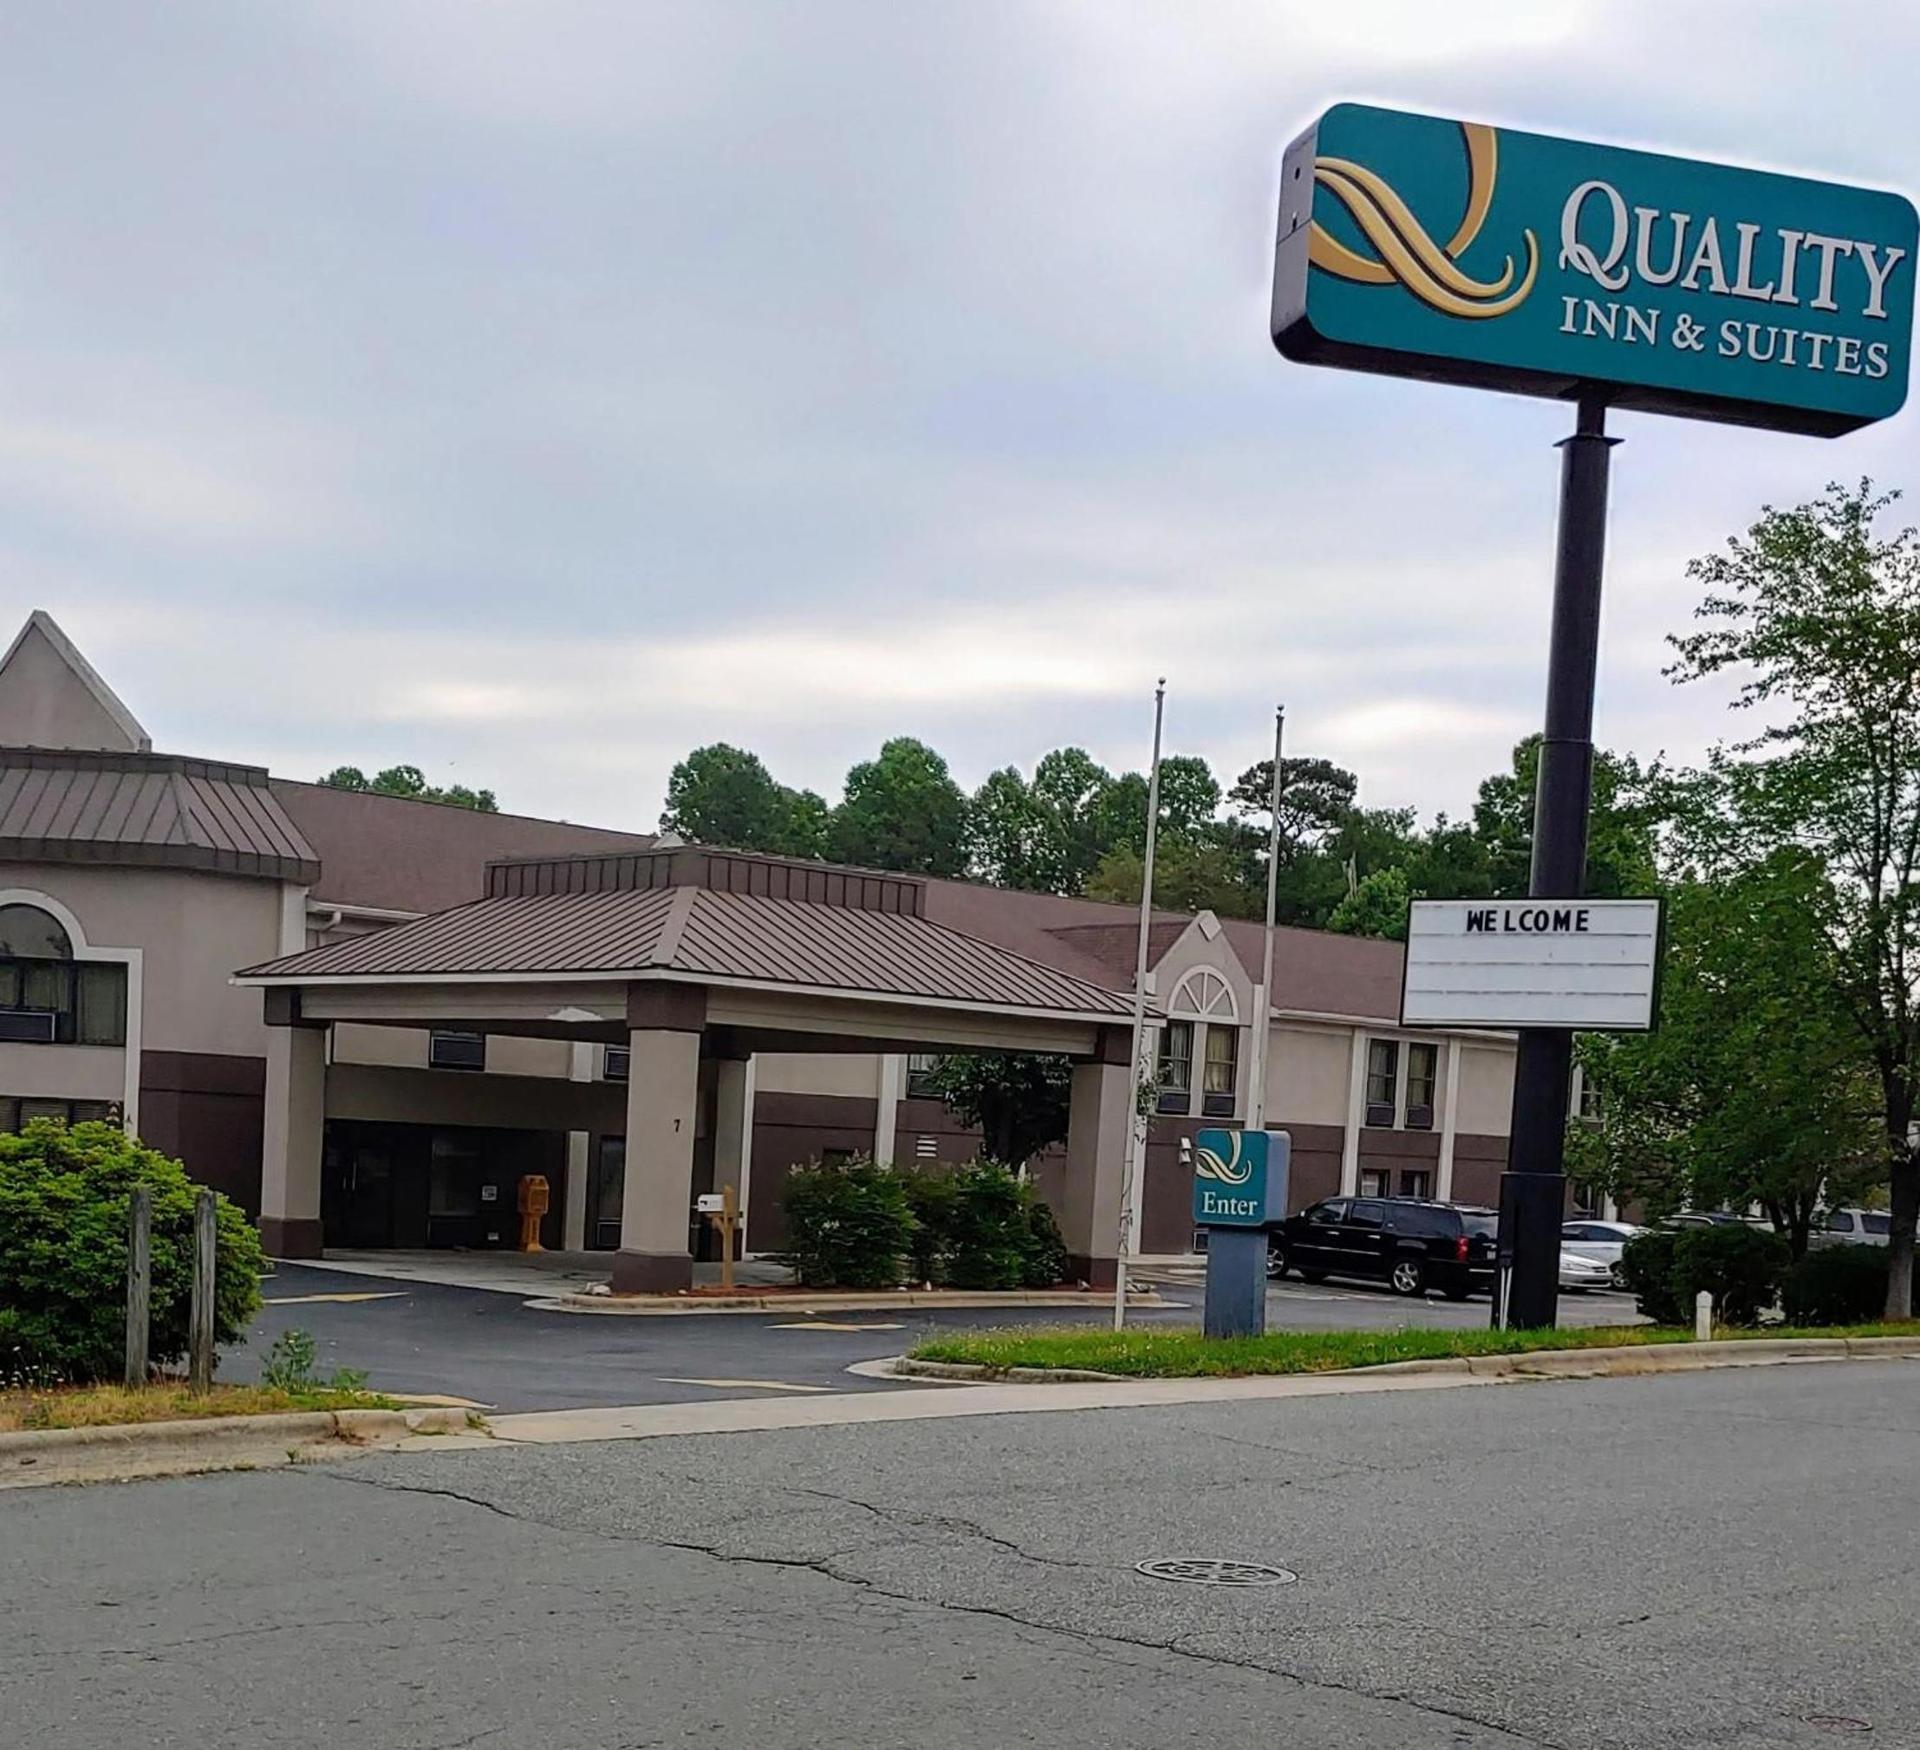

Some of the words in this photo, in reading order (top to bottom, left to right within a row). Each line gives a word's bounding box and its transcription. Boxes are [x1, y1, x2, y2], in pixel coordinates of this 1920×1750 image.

[1558, 180, 1906, 319] QUALITY
[1559, 296, 1661, 345] INN
[1671, 312, 1706, 351] &
[1718, 319, 1889, 378] SUITES
[1466, 909, 1589, 932] WELCOME
[673, 1118, 681, 1133] 7
[1202, 1191, 1258, 1216] Enter
